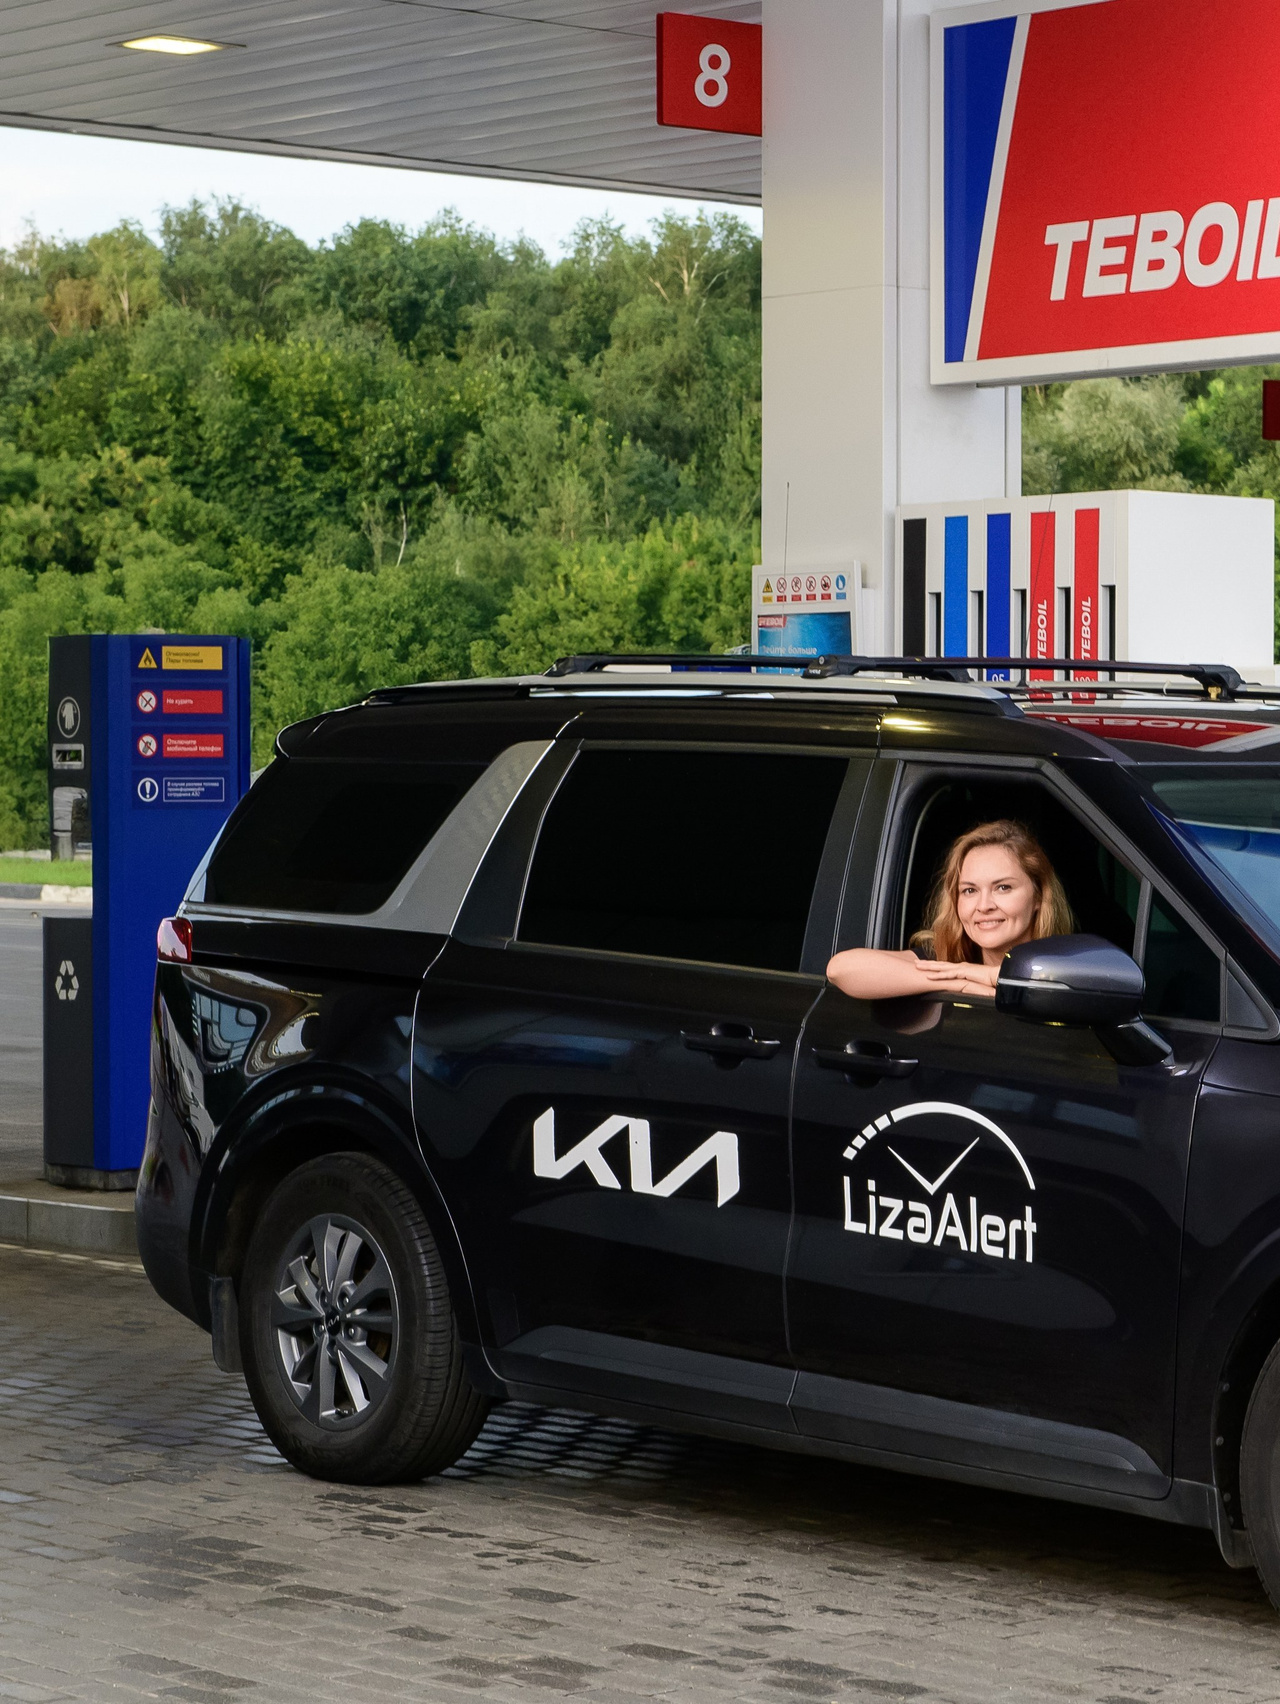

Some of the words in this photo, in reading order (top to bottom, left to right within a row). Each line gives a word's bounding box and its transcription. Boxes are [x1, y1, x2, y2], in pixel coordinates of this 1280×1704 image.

[694, 43, 731, 108] 8
[788, 644, 818, 655] больше
[1037, 599, 1047, 659] TEBOIL
[1081, 596, 1091, 660] TEBOIL
[533, 1106, 740, 1208] KIA
[843, 1175, 1037, 1263] LizaAlert
